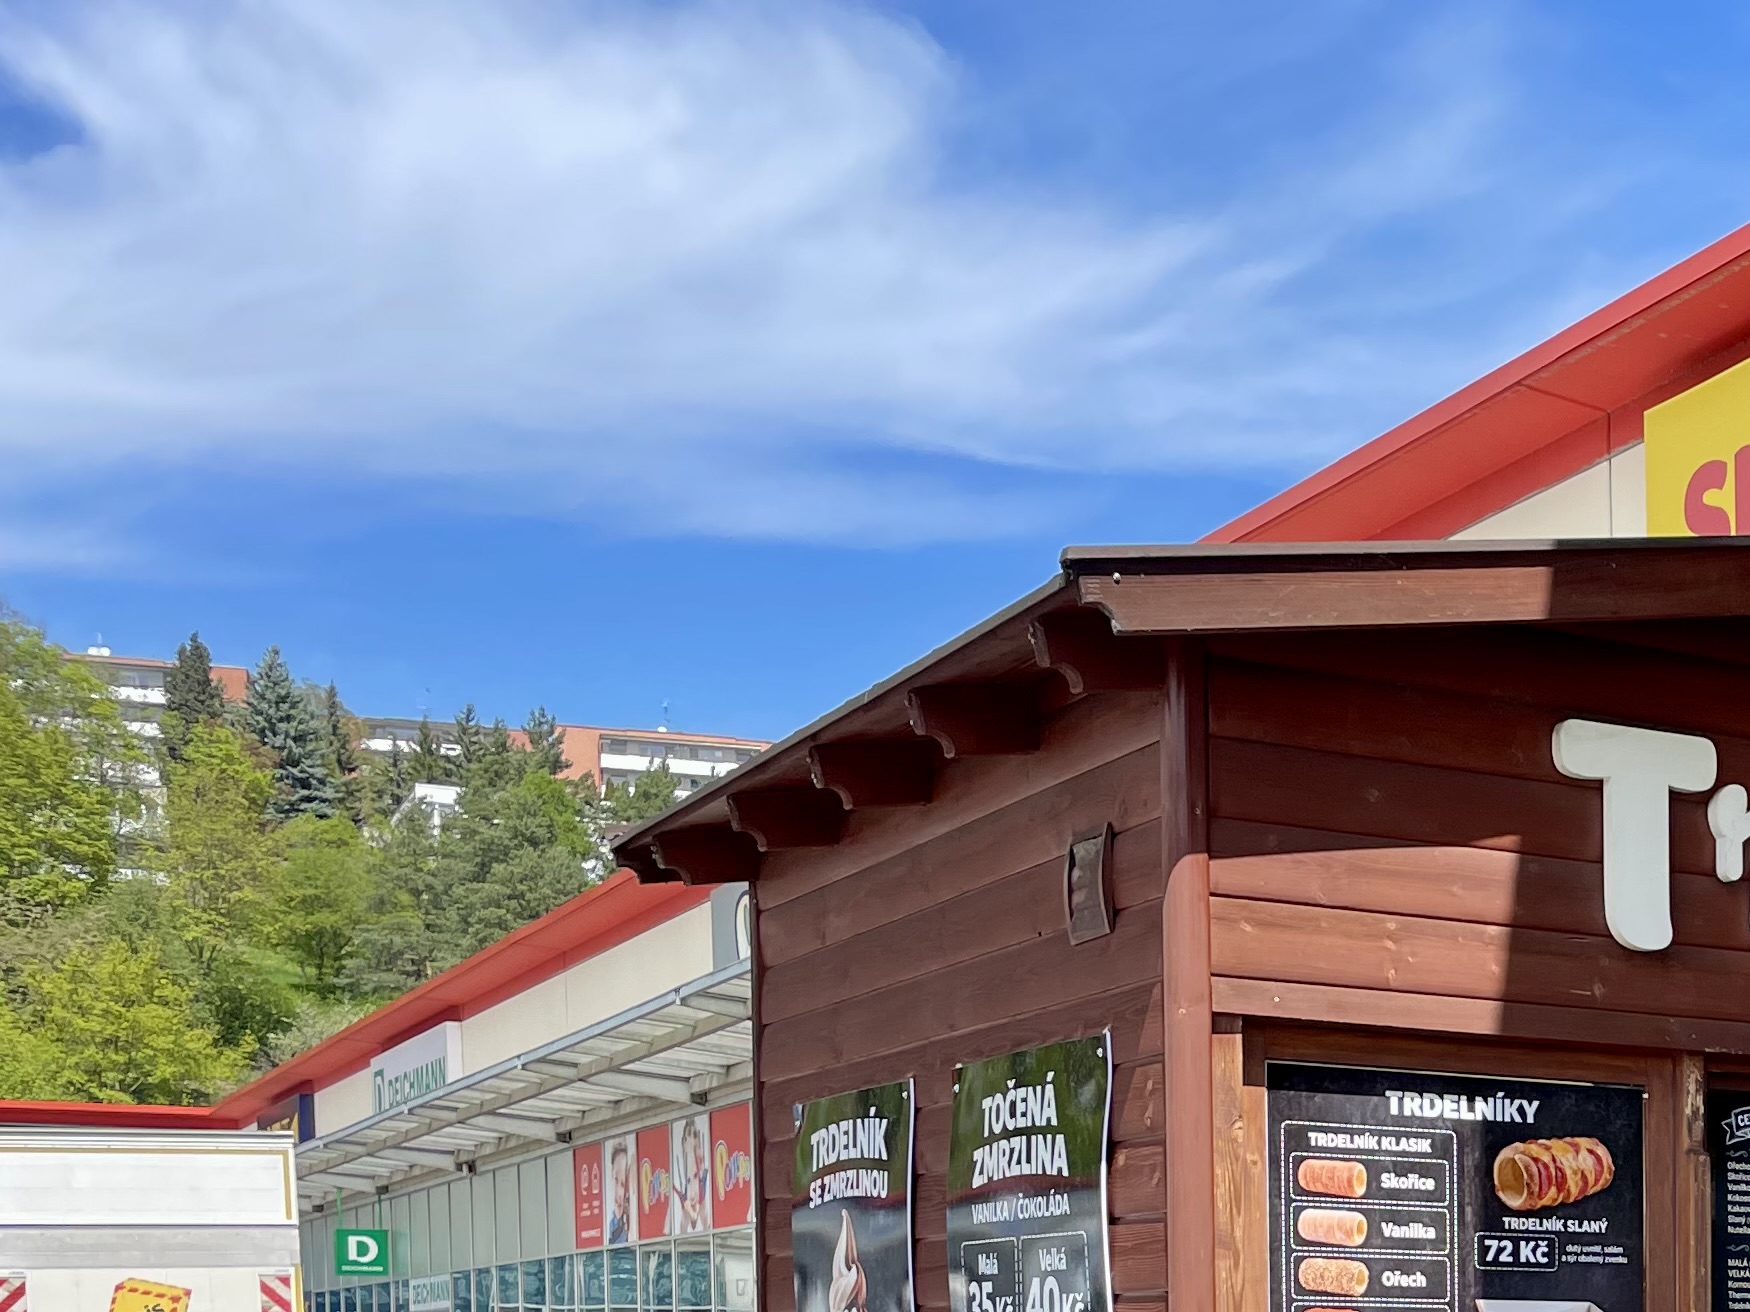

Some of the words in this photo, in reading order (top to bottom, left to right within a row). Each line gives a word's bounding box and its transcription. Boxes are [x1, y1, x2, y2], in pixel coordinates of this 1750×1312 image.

[387, 1055, 447, 1109] DEICHMANN
[982, 1071, 1057, 1137] TOČENÁ
[1385, 1089, 1540, 1124] TRDELNÍKY
[811, 1107, 887, 1173] TRDELNÍK
[1308, 1132, 1378, 1150] TRDELNÍK
[1381, 1136, 1432, 1152] KLASIK
[972, 1134, 1069, 1188] ZMRZLINA
[809, 1180, 822, 1208] SE
[824, 1169, 888, 1202] ZMRZLINOU
[1381, 1173, 1435, 1190] Skořice
[972, 1198, 1010, 1224] VANILKA
[1017, 1189, 1070, 1219] ČOKOLÁDA
[1381, 1222, 1436, 1239] Vanilka
[1502, 1216, 1564, 1231] TRDELNÍK
[1567, 1218, 1608, 1233] SLANÝ
[347, 1234, 379, 1264] D
[1038, 1247, 1067, 1272] Velká
[1484, 1239, 1513, 1262] 72
[1520, 1240, 1548, 1263] Kč
[978, 1252, 998, 1275] Malá
[1728, 1257, 1748, 1267] MALÁ
[1728, 1269, 1750, 1278] VELKÁ
[1382, 1271, 1426, 1287] Ořech
